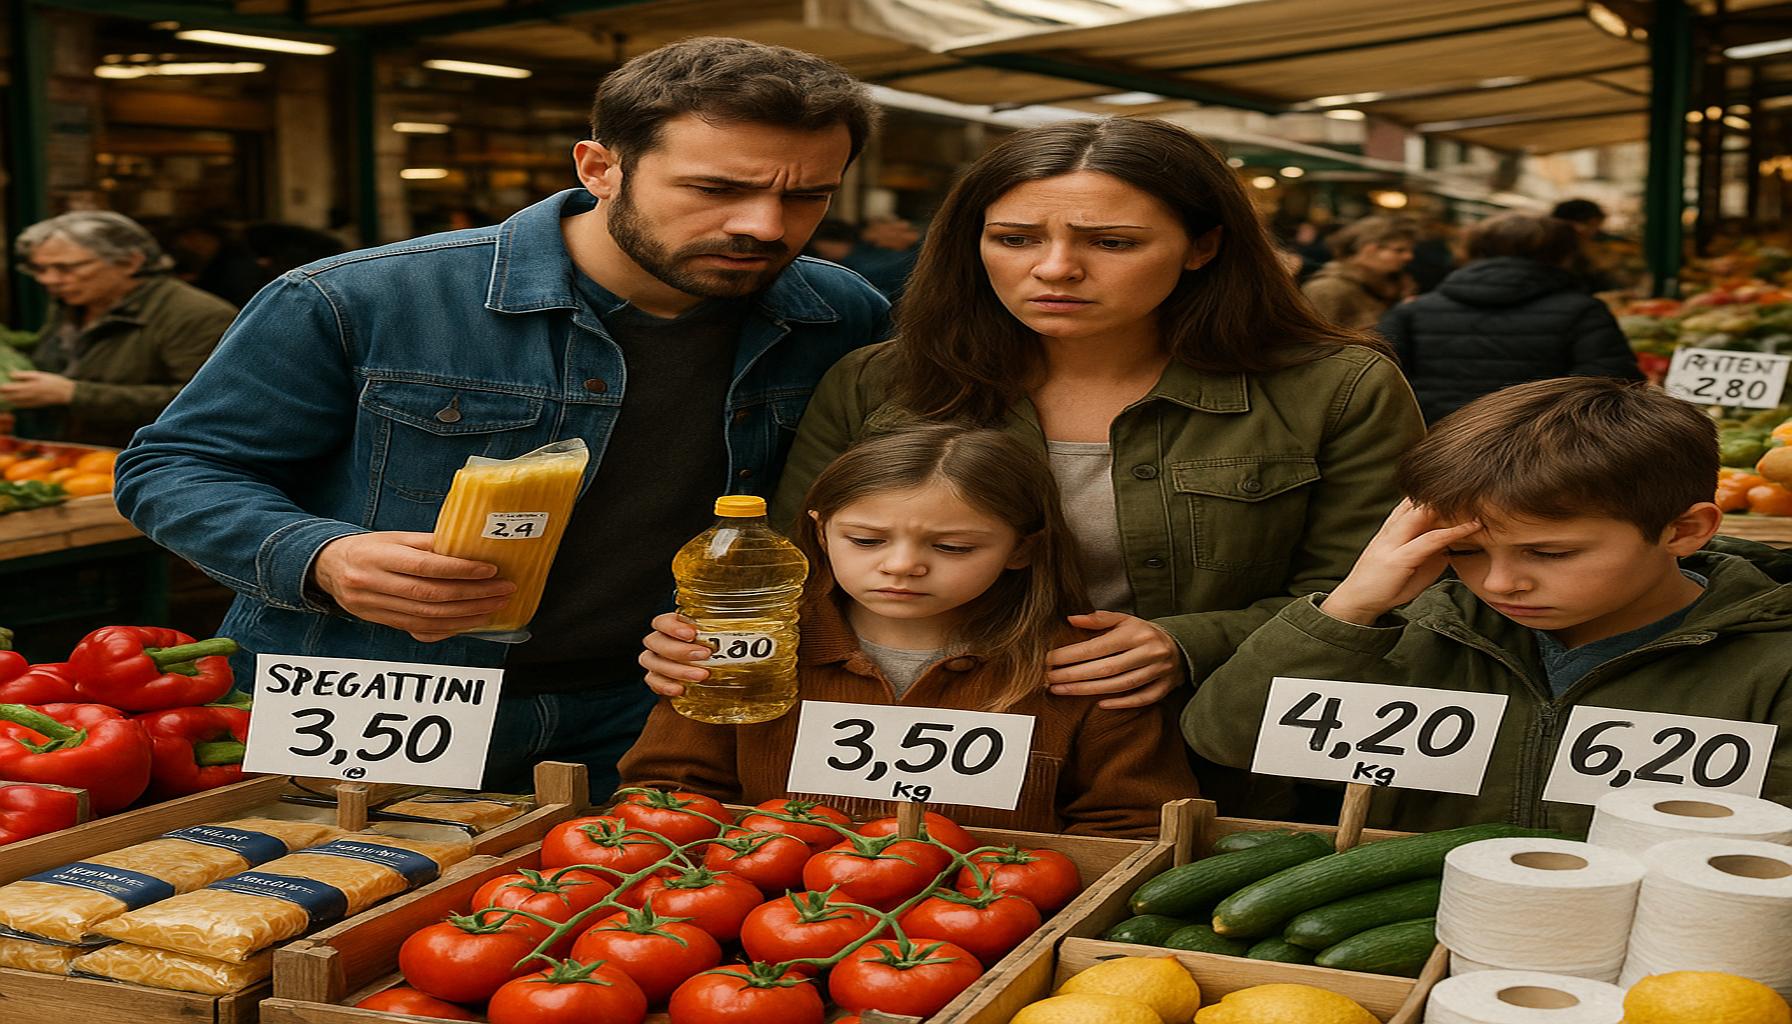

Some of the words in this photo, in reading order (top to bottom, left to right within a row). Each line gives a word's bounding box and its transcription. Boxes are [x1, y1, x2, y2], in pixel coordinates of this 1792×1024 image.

[266, 663, 485, 705] SPEGATTINI
[288, 708, 452, 765] 3,50
[827, 719, 1004, 781] 3,50
[1279, 692, 1475, 759] 4,20
[1571, 720, 1751, 788] 6,20
